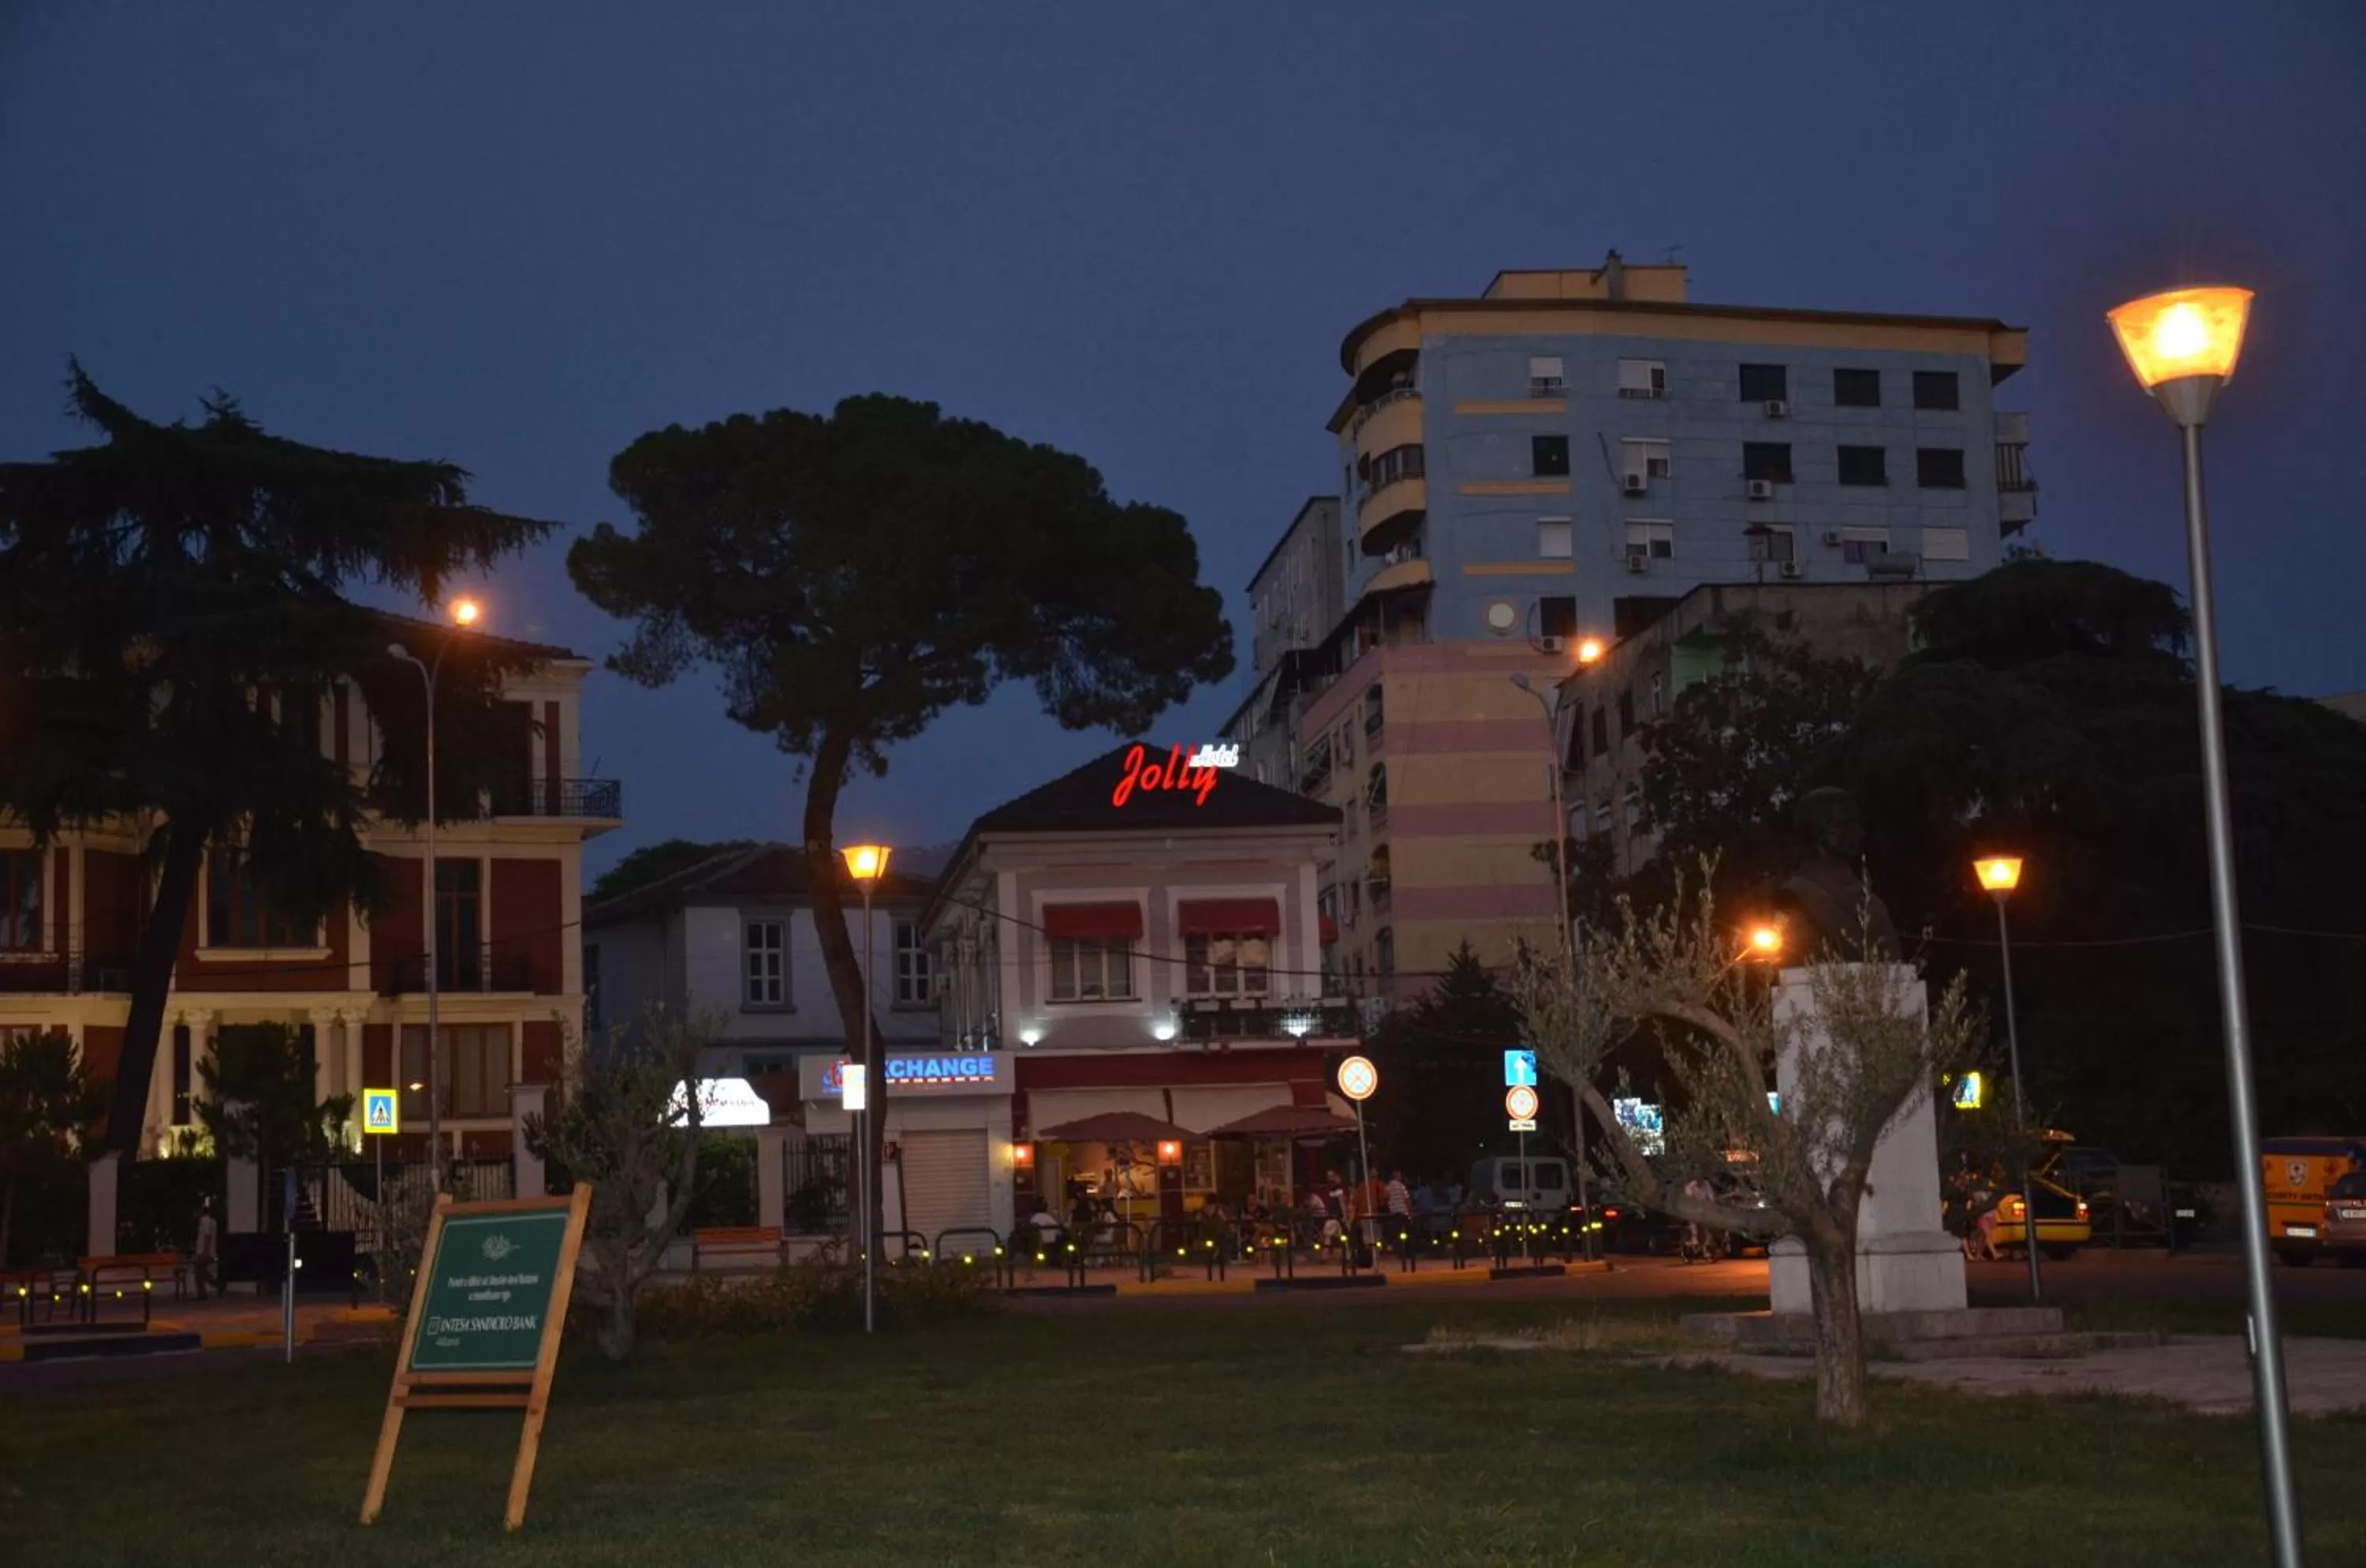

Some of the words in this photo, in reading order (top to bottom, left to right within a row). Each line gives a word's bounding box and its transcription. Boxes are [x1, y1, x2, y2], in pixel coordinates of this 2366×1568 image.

[1112, 741, 1218, 808] Jolly
[884, 1056, 995, 1078] CHANGE
[512, 1315, 536, 1331] BANK
